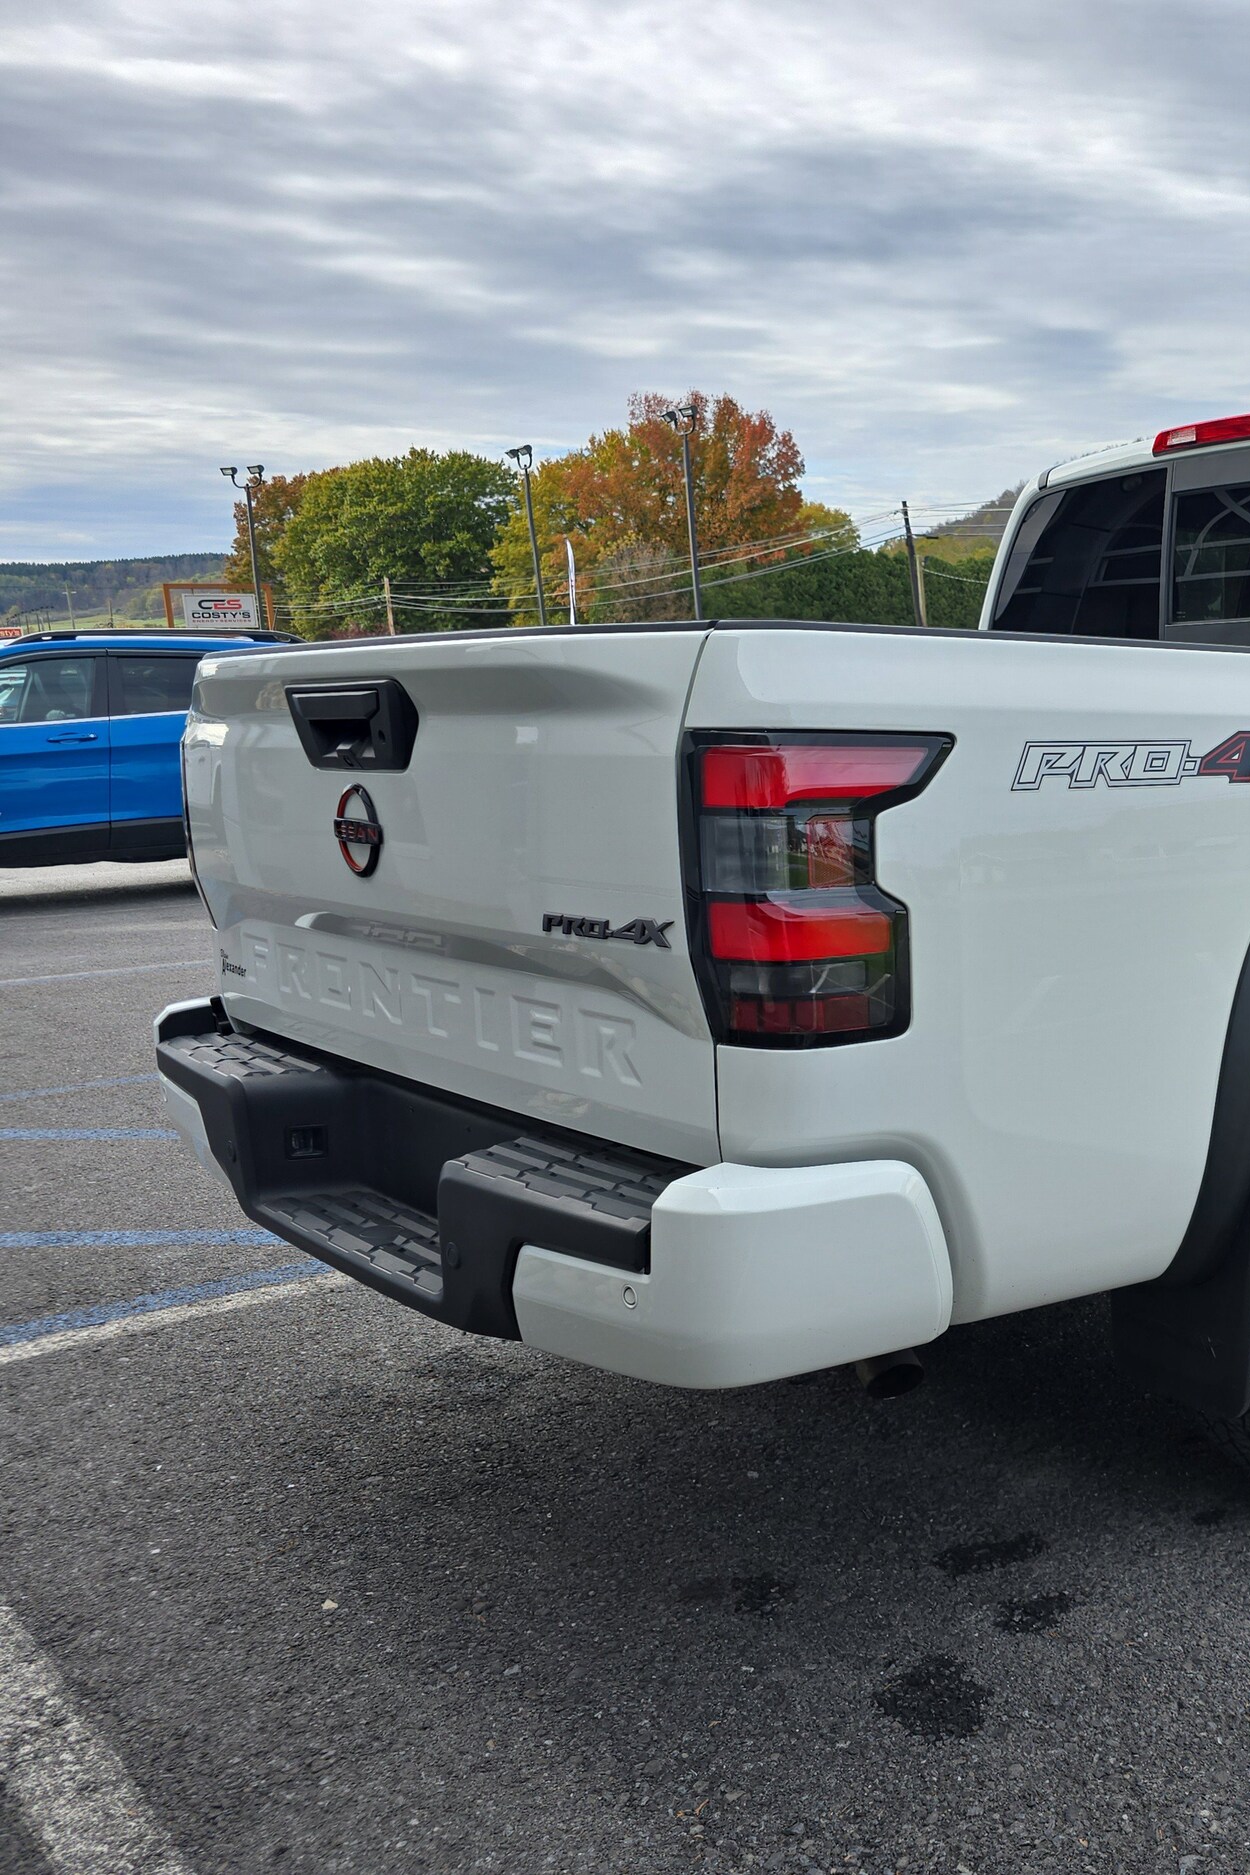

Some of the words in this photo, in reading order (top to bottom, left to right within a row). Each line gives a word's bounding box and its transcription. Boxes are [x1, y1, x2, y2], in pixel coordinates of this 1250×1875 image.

[192, 611, 251, 619] COSTY'S
[542, 911, 675, 949] PRO-4X
[239, 931, 645, 1087] FRONTIER
